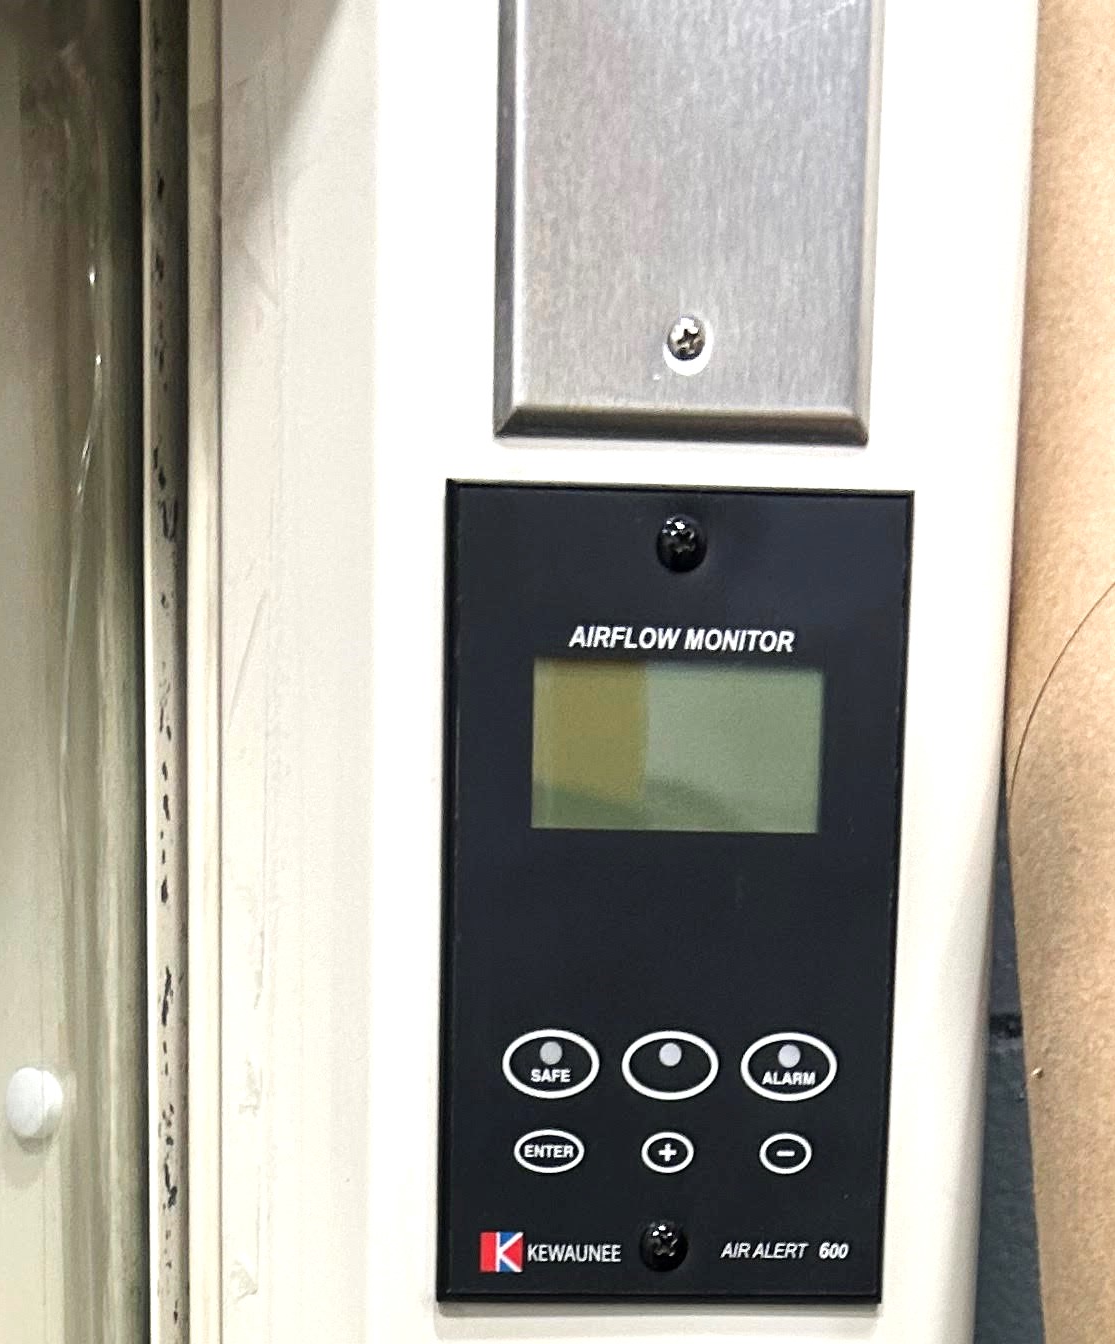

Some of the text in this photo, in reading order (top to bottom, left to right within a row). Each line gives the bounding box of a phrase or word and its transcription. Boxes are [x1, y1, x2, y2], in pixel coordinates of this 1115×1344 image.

[568, 625, 796, 653] AIRFLOW MONITOR
[531, 1068, 572, 1083] SAFE
[762, 1071, 817, 1086] ALARM
[524, 1144, 575, 1159] ENTER
[526, 1243, 622, 1263] KEWAUNEE
[720, 1241, 850, 1260] AIR ALERT 600
